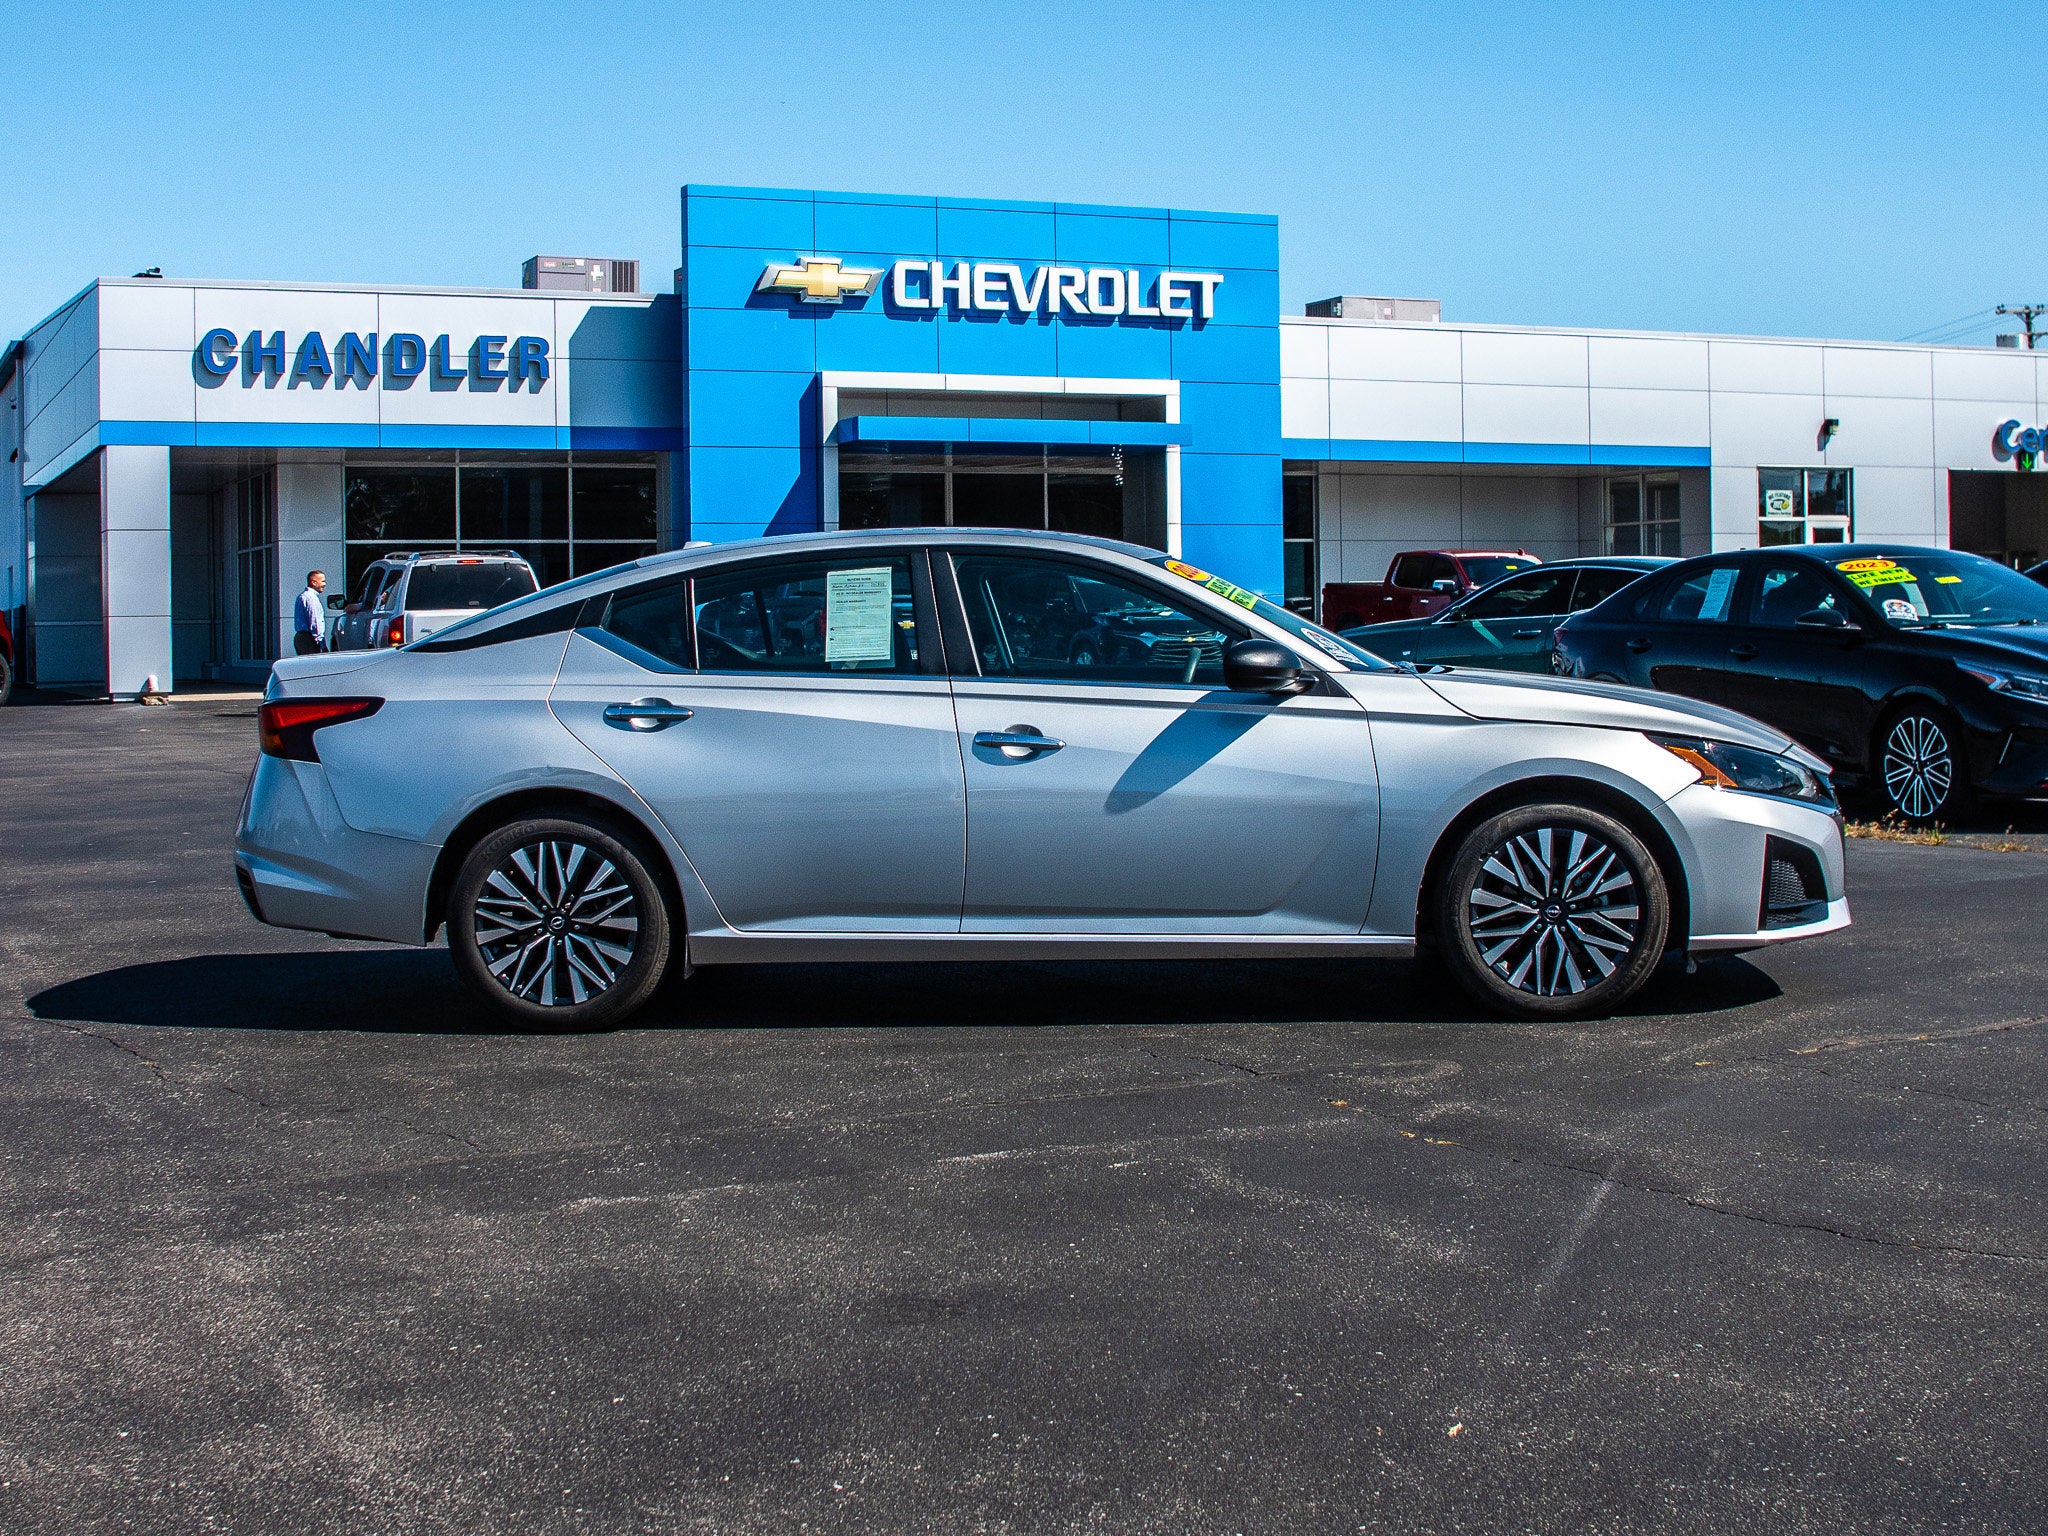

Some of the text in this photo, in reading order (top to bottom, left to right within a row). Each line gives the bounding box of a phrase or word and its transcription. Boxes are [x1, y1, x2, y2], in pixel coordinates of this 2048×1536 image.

[894, 260, 1224, 319] CHEVROLET
[202, 328, 550, 379] CHANDLER
[1844, 560, 1889, 570] 2023
